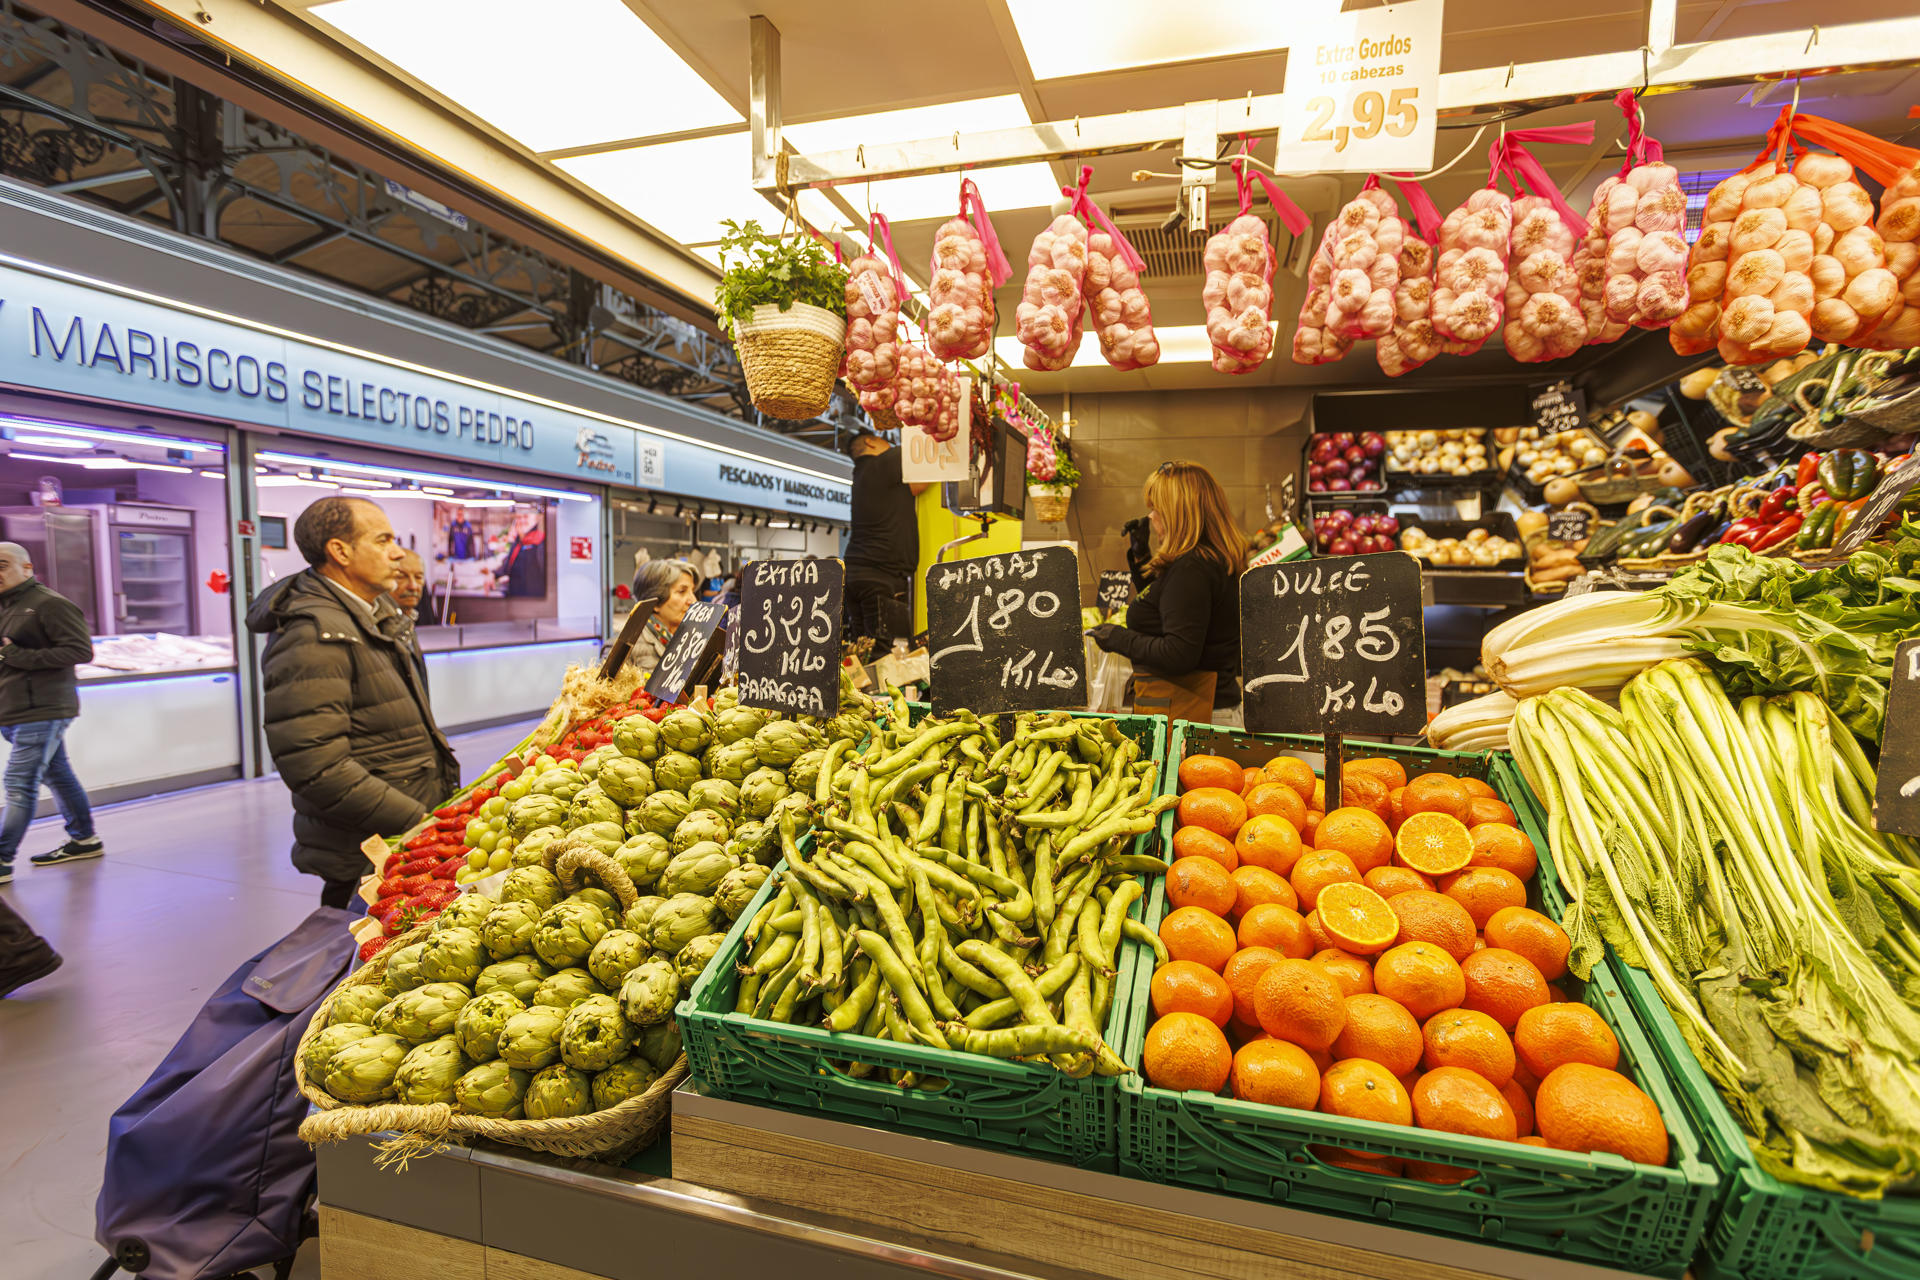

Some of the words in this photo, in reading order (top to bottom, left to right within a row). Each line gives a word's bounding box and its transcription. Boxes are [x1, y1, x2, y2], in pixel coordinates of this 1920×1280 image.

[1316, 44, 1354, 66] Extra
[1359, 34, 1412, 60] Gordos
[1320, 70, 1337, 84] 10
[1341, 64, 1404, 82] cabezas
[1301, 87, 1419, 153] 2,95
[29, 306, 289, 404] MARISCOS
[302, 370, 450, 435] SELECTOS
[457, 406, 534, 450] PEDRO
[719, 464, 774, 490] PESCADOS
[776, 477, 782, 491] Y
[784, 479, 825, 500] MARISCOS
[755, 561, 819, 587] EXTRA
[938, 552, 1048, 591] HABAS
[1272, 562, 1371, 598] DULCE
[744, 589, 833, 654] 3'25
[929, 584, 1061, 670] 1'80
[662, 627, 707, 671] 3'80
[1244, 605, 1401, 693] 1'85
[740, 672, 824, 711] ZARAGOZA
